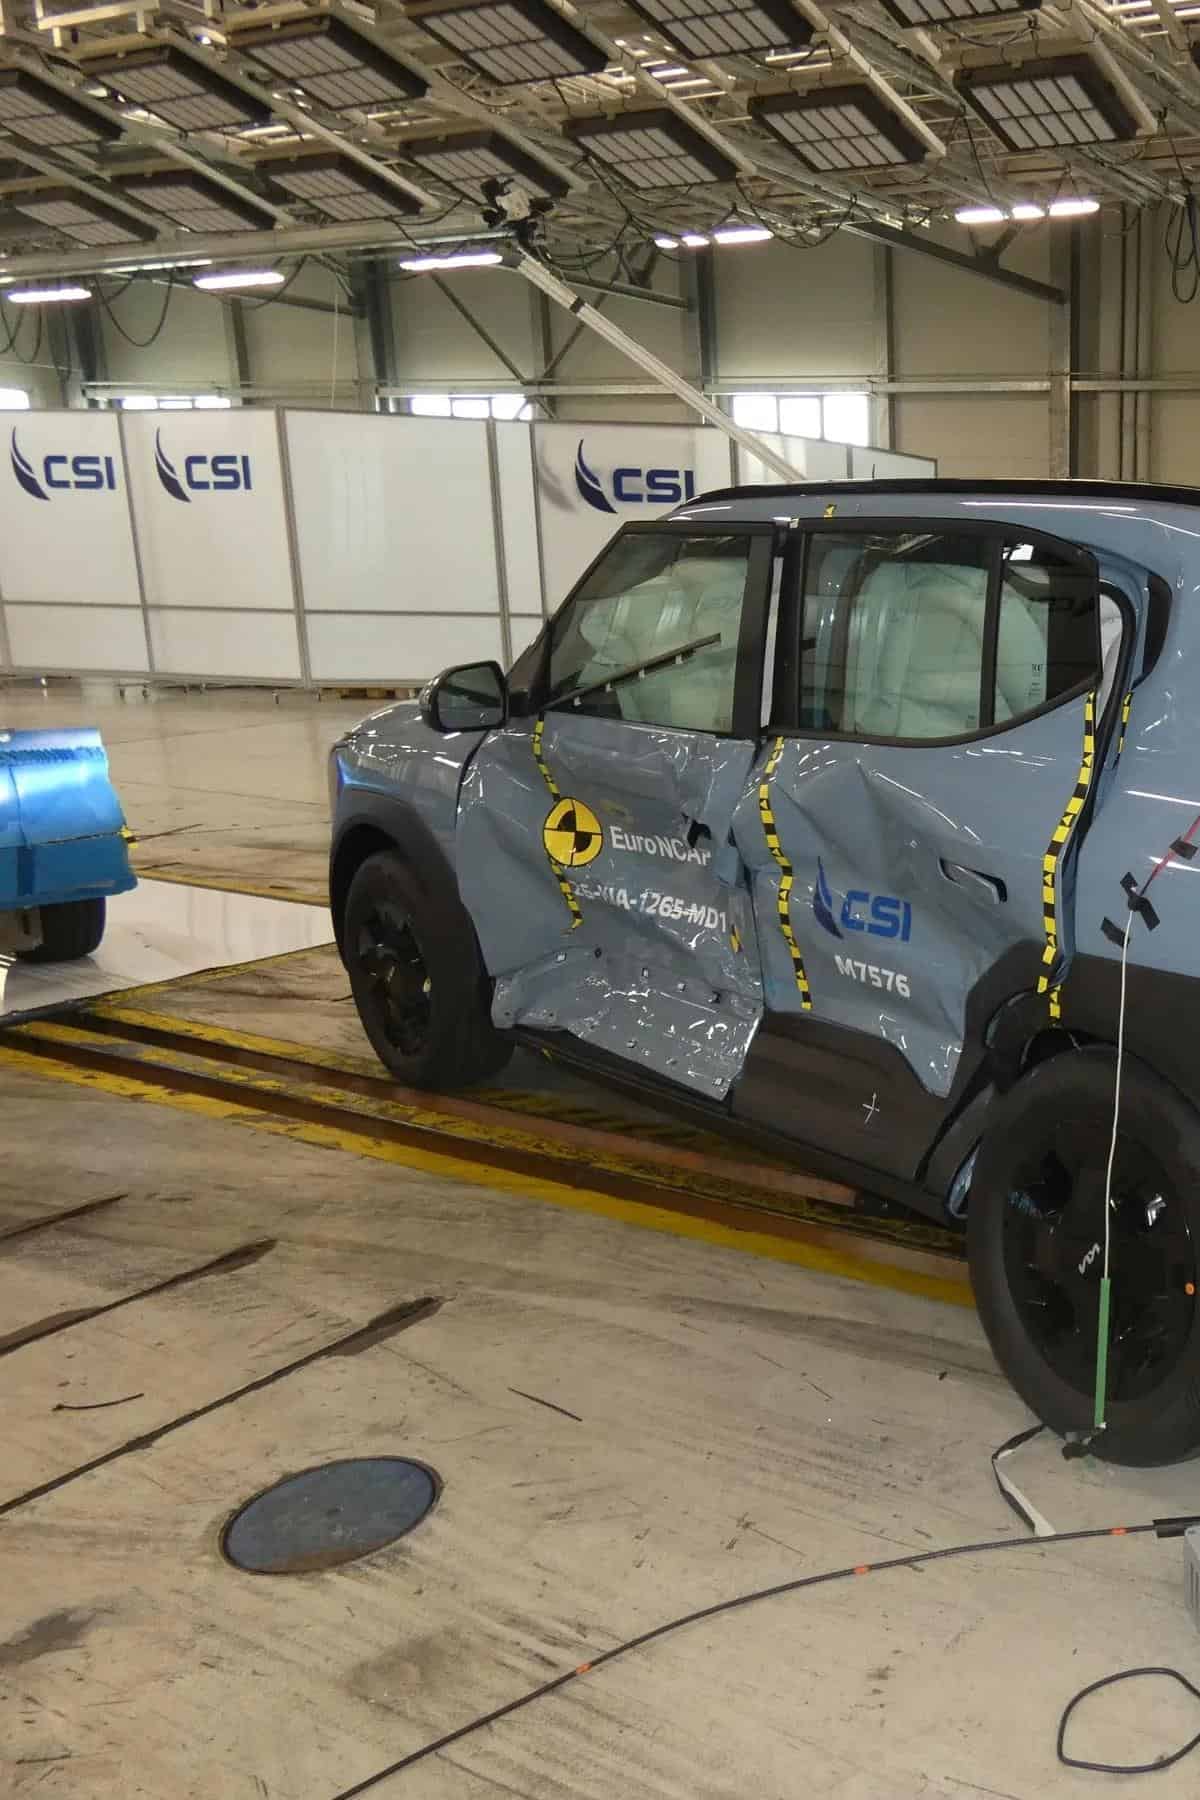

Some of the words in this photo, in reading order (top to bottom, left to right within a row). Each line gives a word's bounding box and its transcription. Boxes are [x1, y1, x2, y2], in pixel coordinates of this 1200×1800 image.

[44, 455, 116, 489] CSI
[185, 455, 252, 490] CSI
[612, 468, 694, 503] CSI
[841, 890, 912, 943] CSI
[834, 953, 911, 998] M7576
